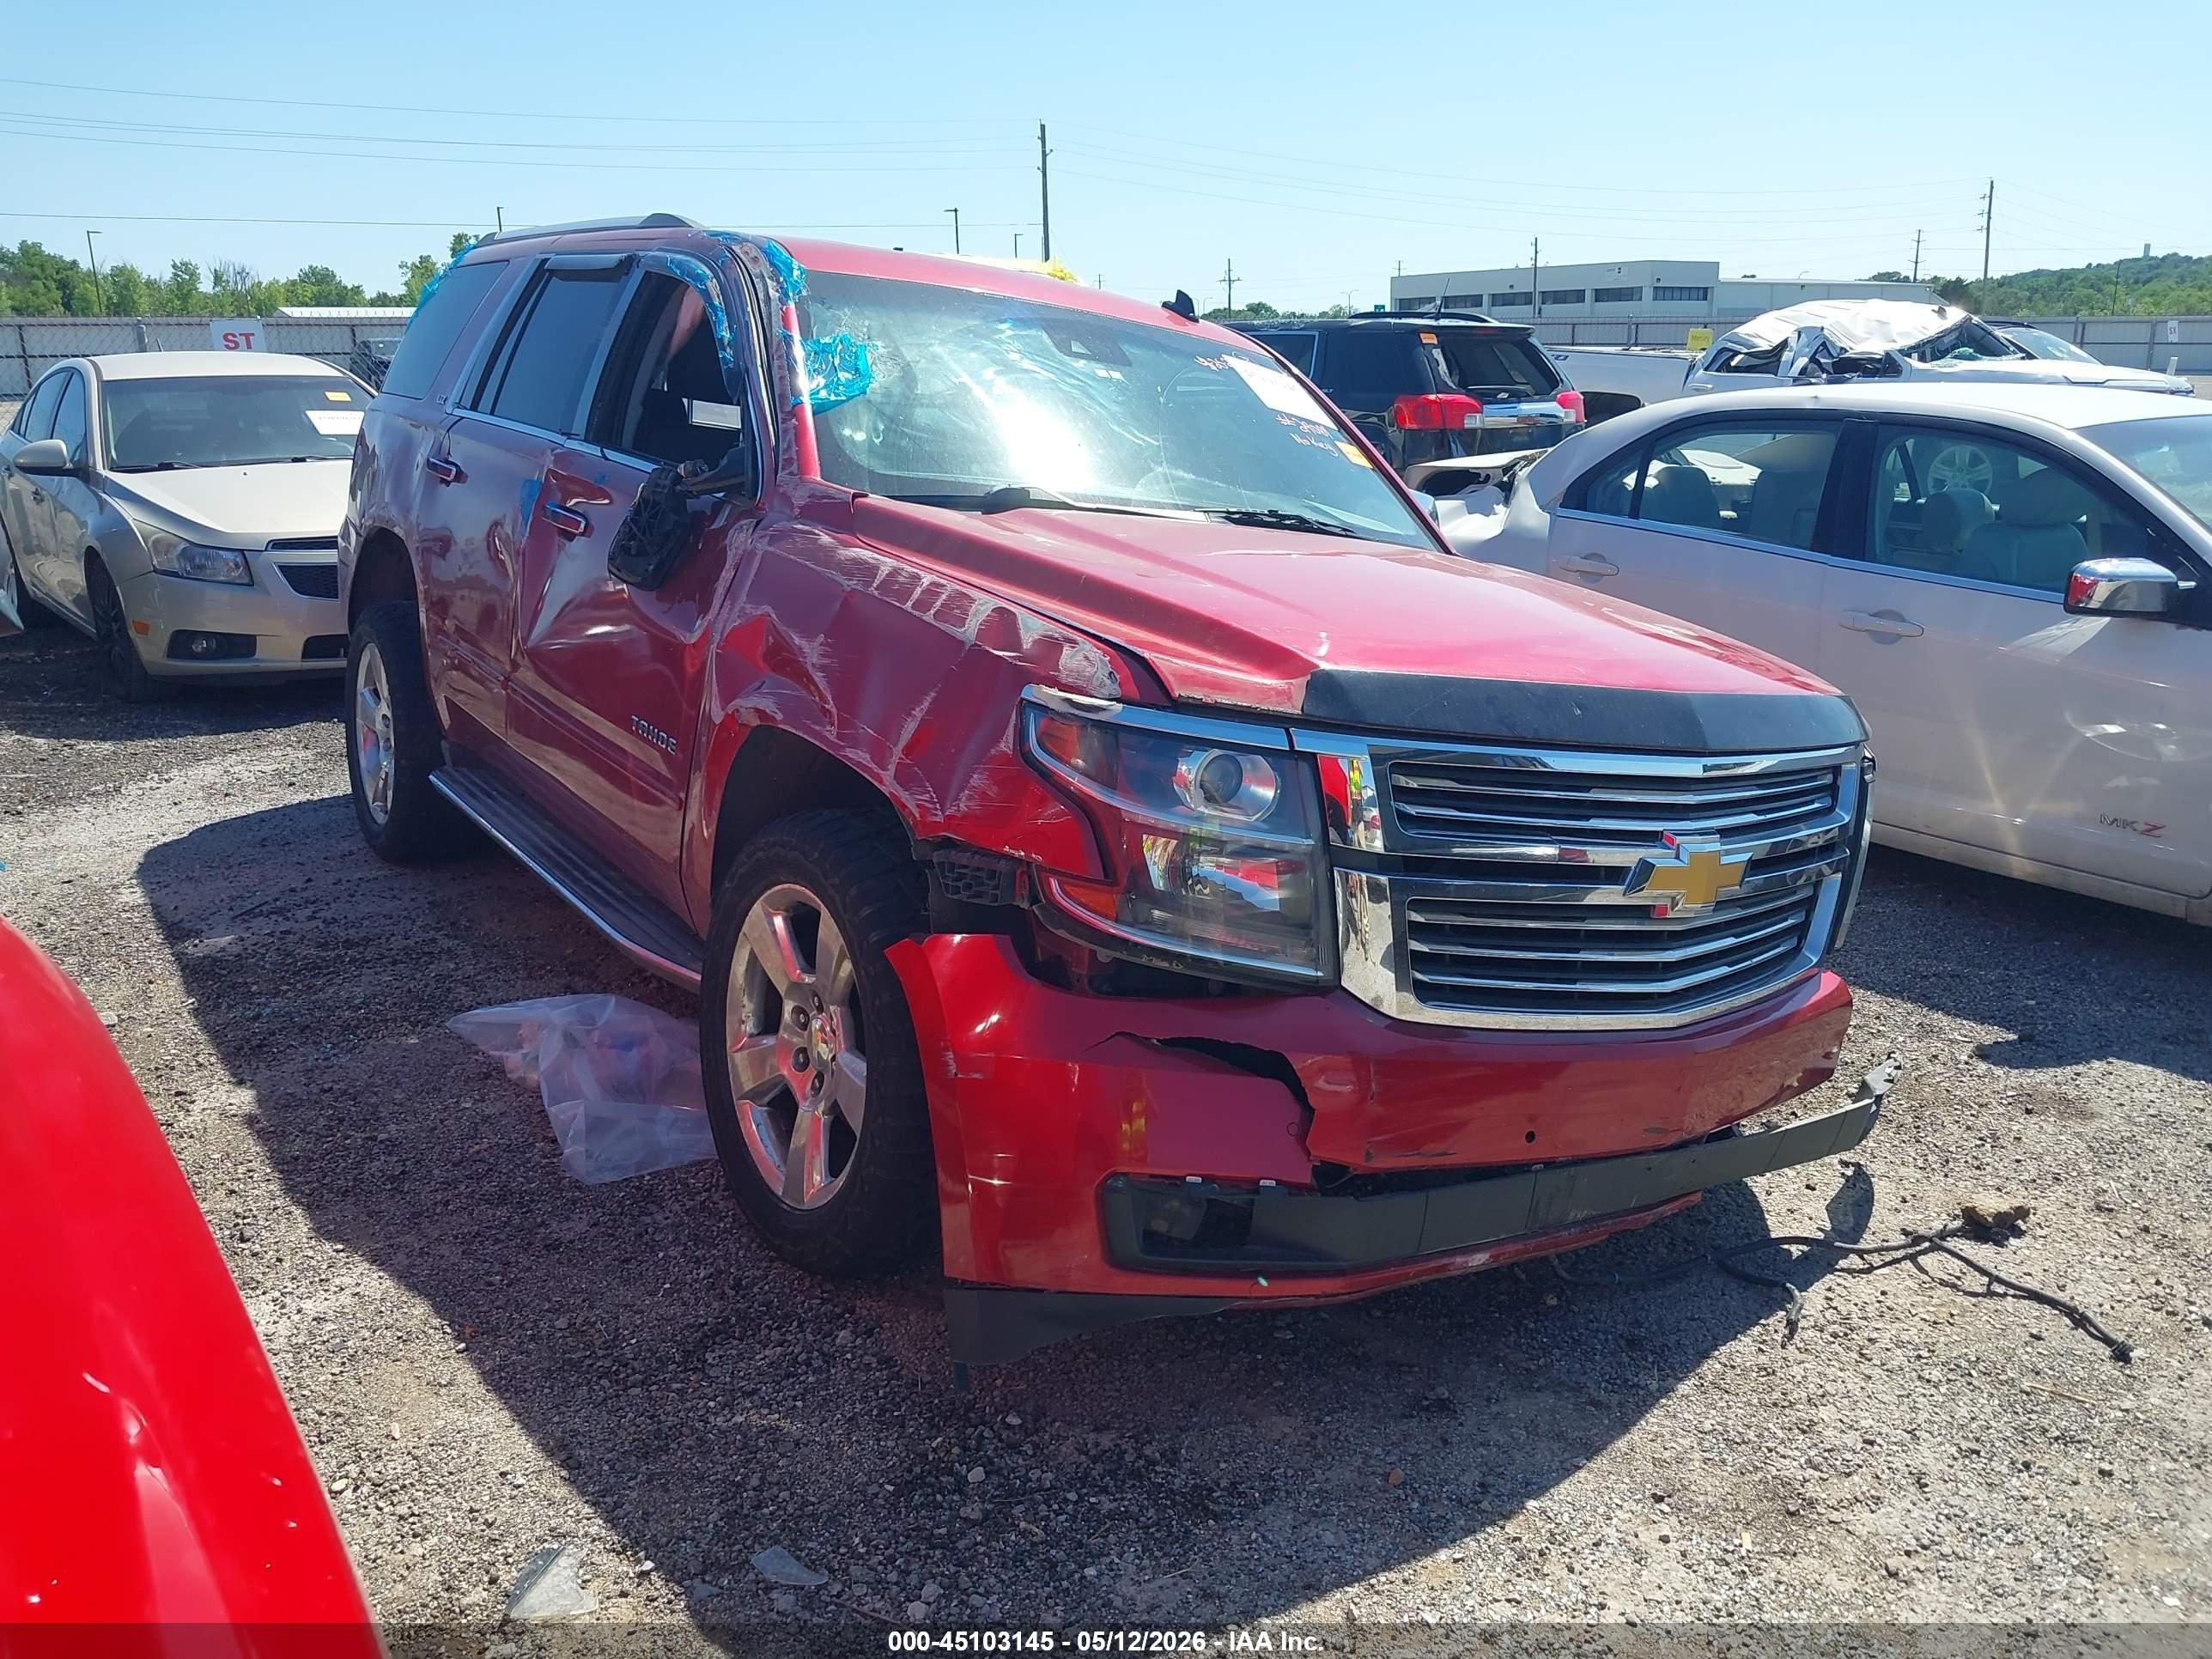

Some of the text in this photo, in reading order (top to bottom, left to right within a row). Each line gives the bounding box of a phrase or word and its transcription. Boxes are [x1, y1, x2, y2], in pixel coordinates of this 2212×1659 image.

[222, 332, 256, 350] ST
[631, 714, 677, 756] TAHOE
[2100, 814, 2166, 838] MKZ
